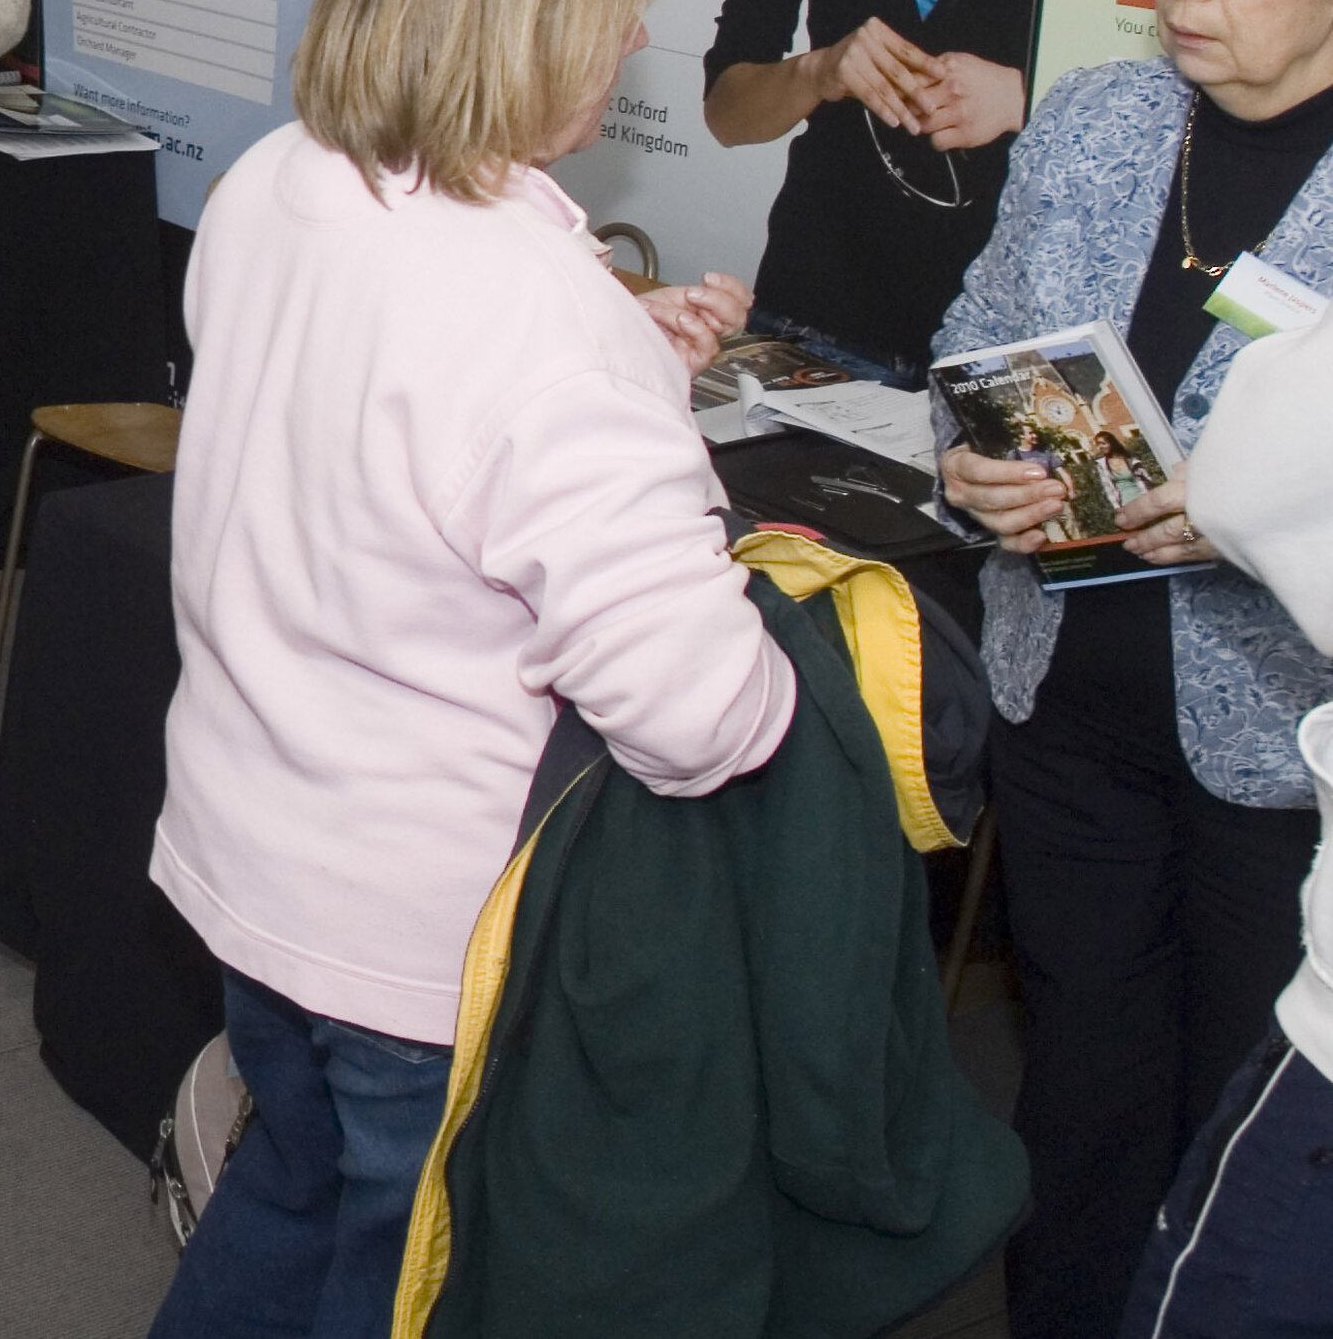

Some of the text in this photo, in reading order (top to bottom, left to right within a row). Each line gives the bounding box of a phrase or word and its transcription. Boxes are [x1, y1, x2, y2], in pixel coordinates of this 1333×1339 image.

[1115, 16, 1143, 35] You
[74, 82, 190, 129] Want more information?
[618, 96, 668, 123] Oxford
[621, 125, 689, 157] Kingdom
[950, 370, 1032, 395] 2010 Calendar
